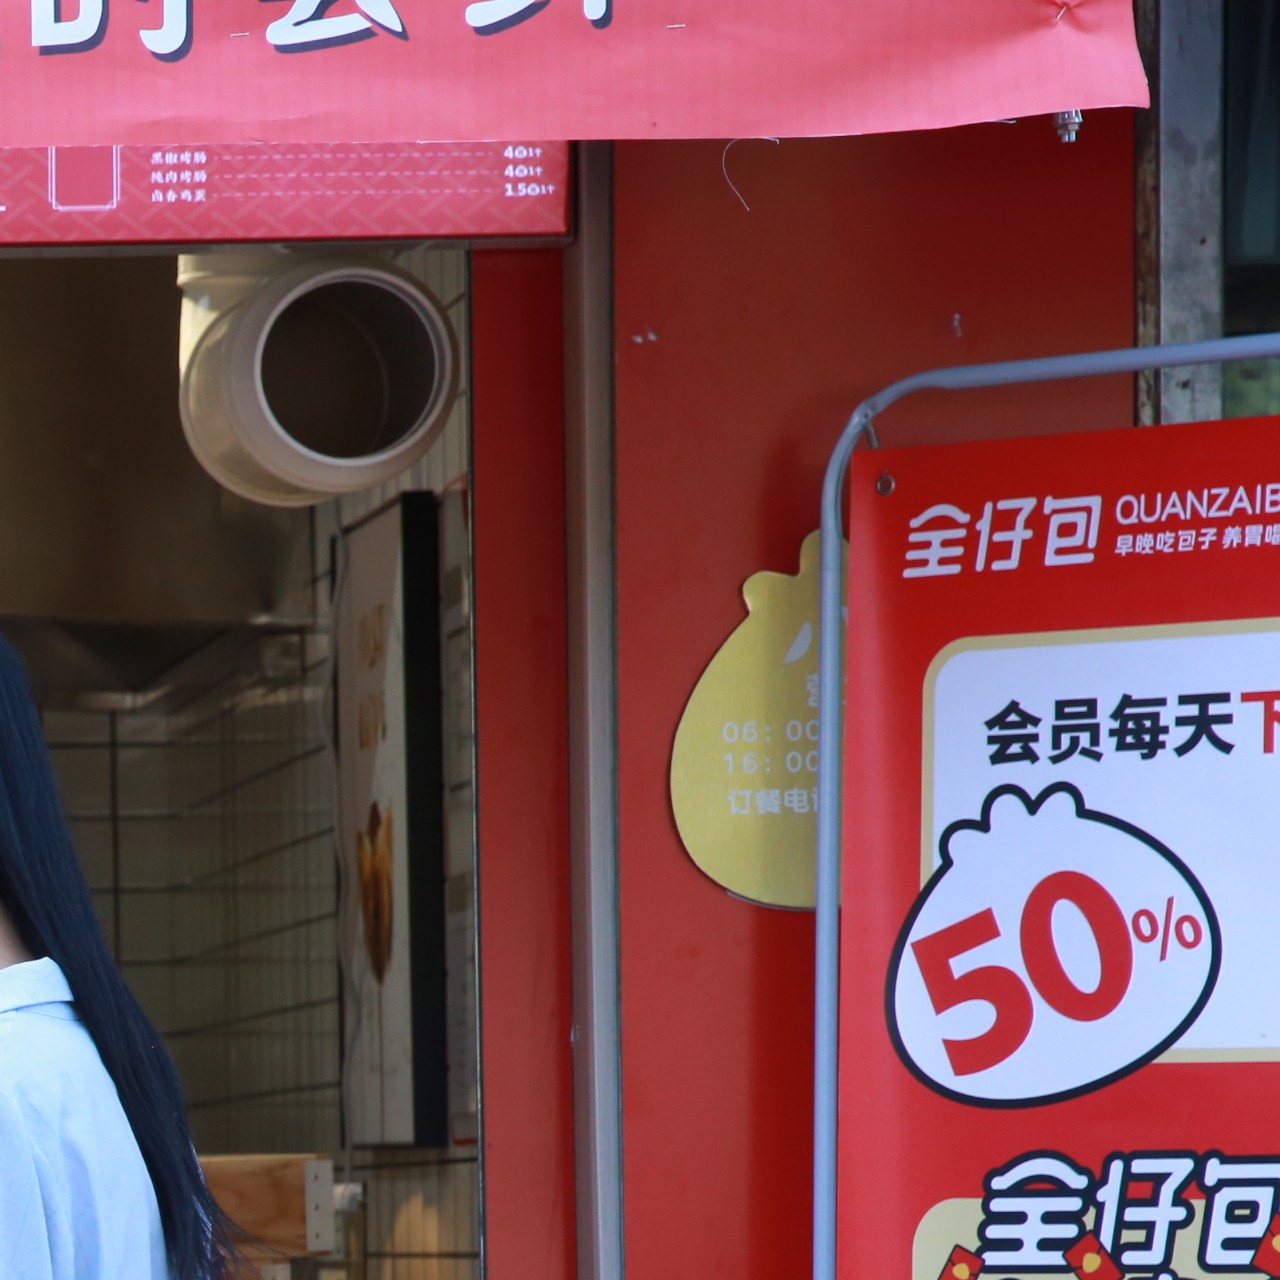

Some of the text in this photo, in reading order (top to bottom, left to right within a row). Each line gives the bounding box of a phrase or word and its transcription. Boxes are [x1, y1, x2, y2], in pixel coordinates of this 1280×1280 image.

[726, 788, 819, 815] 订餐电
[910, 870, 1203, 1077] 50%
